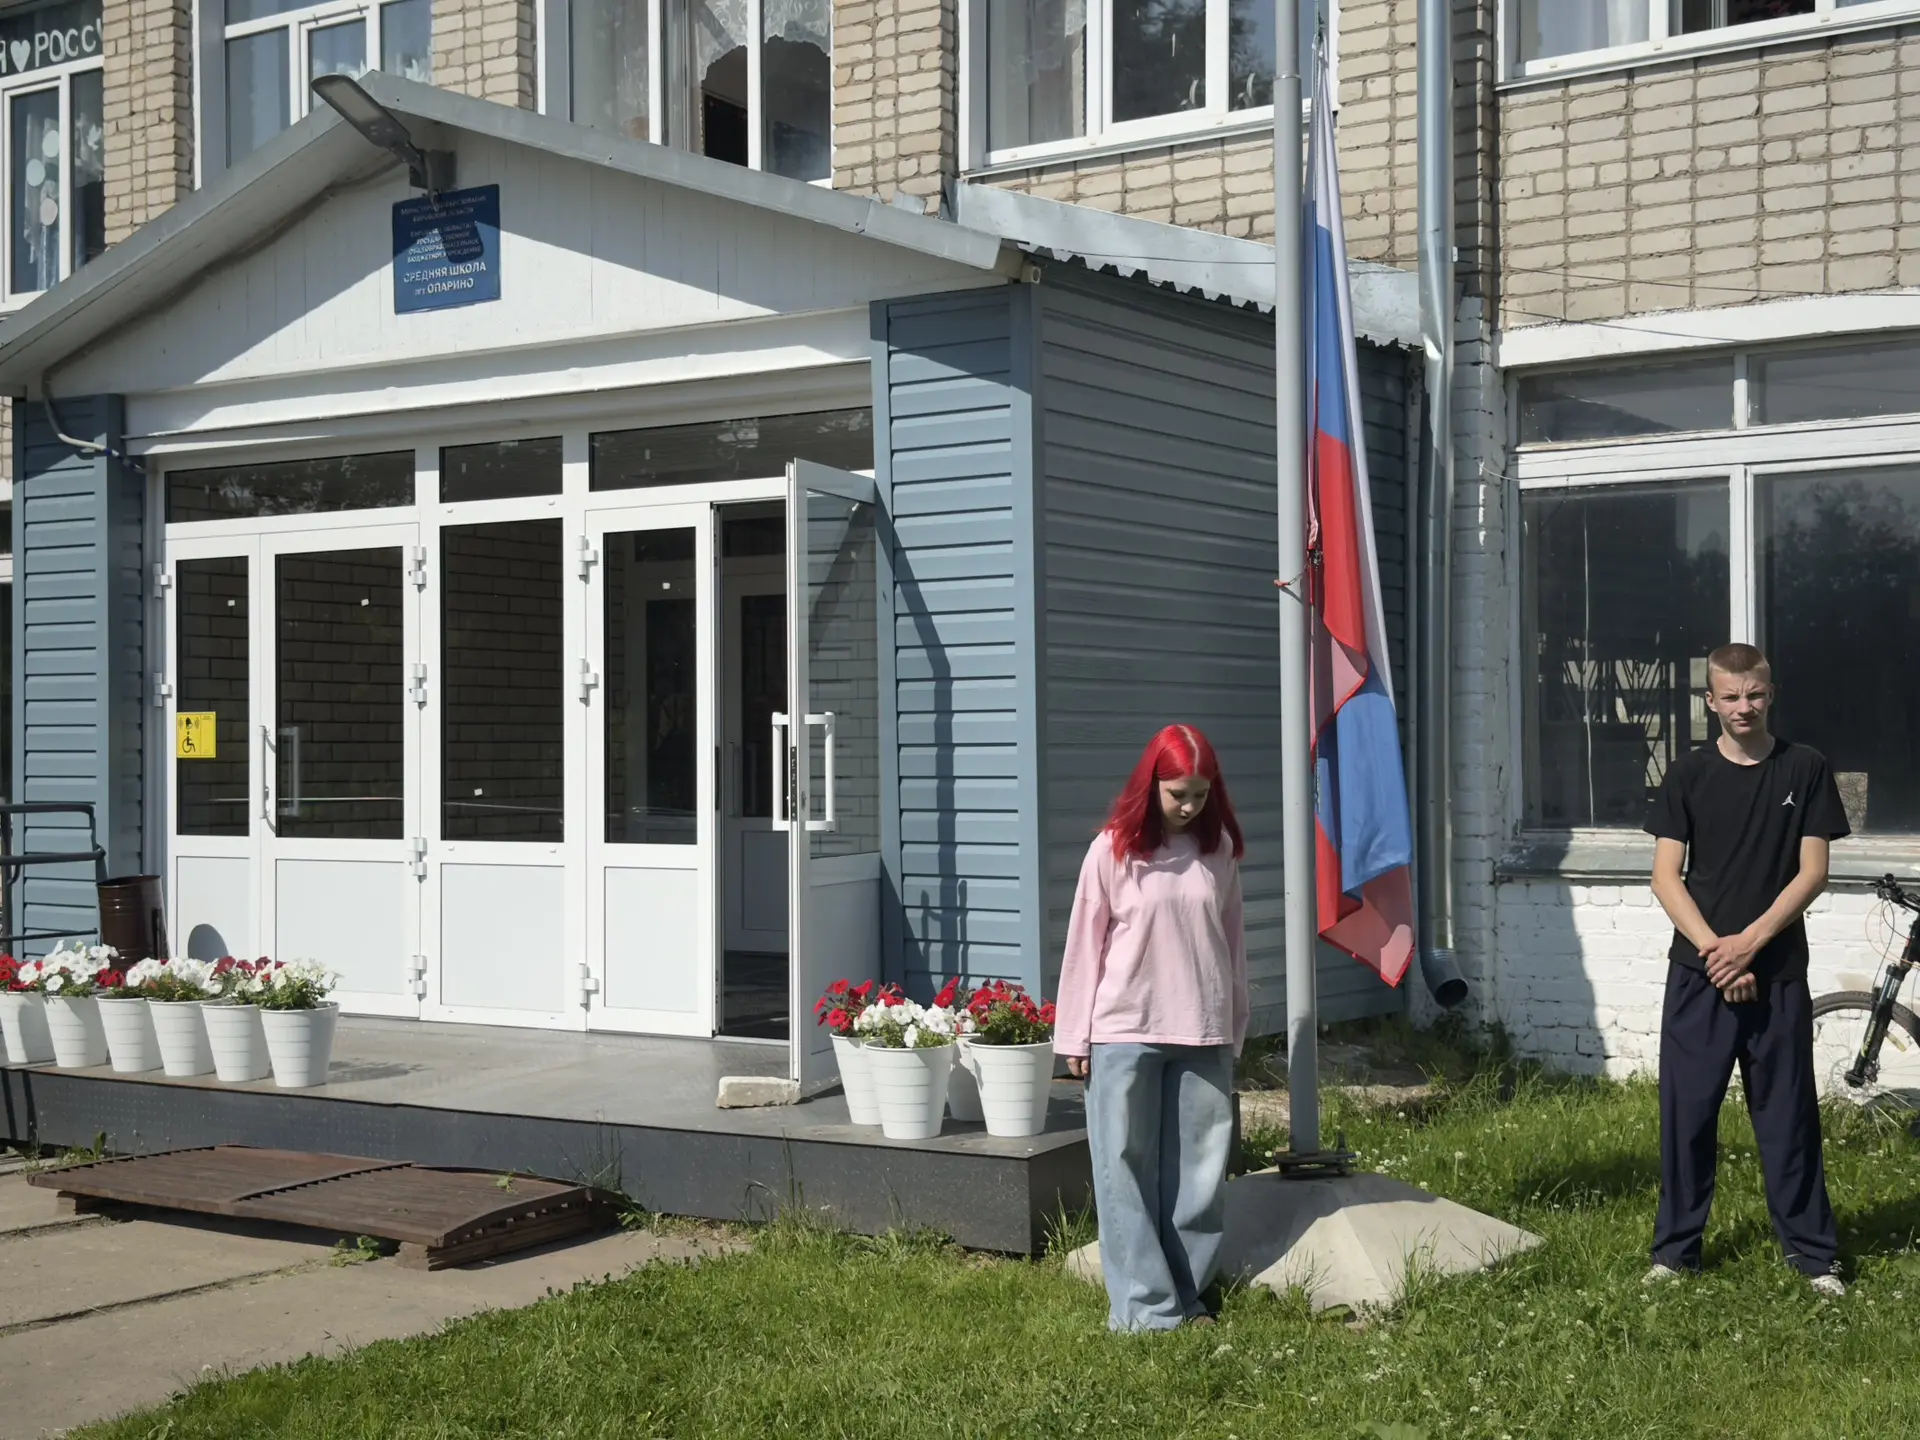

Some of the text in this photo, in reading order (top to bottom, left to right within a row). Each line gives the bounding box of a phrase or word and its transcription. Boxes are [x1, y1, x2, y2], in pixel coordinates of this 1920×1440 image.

[404, 261, 486, 282] СРЕДНЯЯ ШКОЛА
[427, 278, 473, 293] ОПАРИНО
